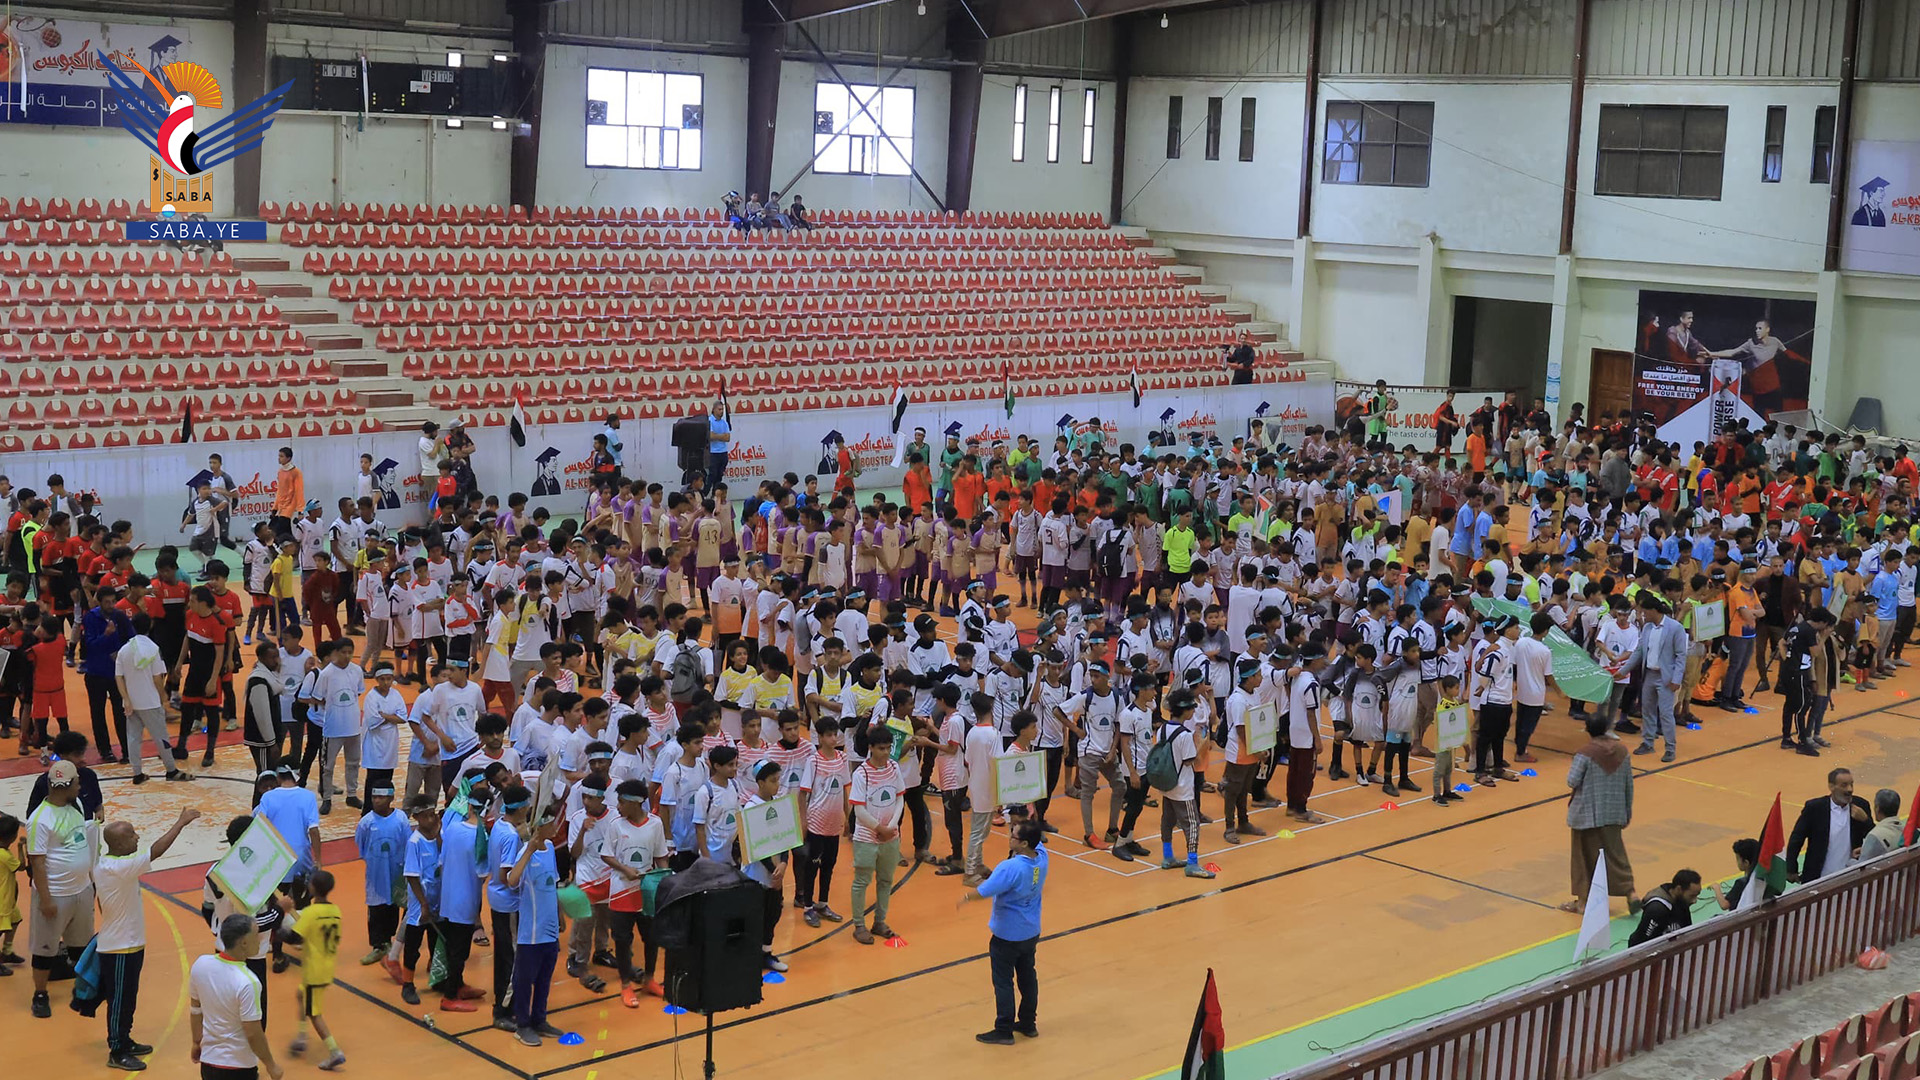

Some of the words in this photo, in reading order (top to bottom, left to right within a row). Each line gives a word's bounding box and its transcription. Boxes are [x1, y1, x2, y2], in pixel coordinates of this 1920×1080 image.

[323, 65, 356, 77] HOME
[422, 70, 453, 83] VISITOR
[1713, 400, 1724, 436] POWER
[1400, 430, 1416, 438] taste
[704, 529, 718, 545] 43
[1045, 529, 1053, 545] 3
